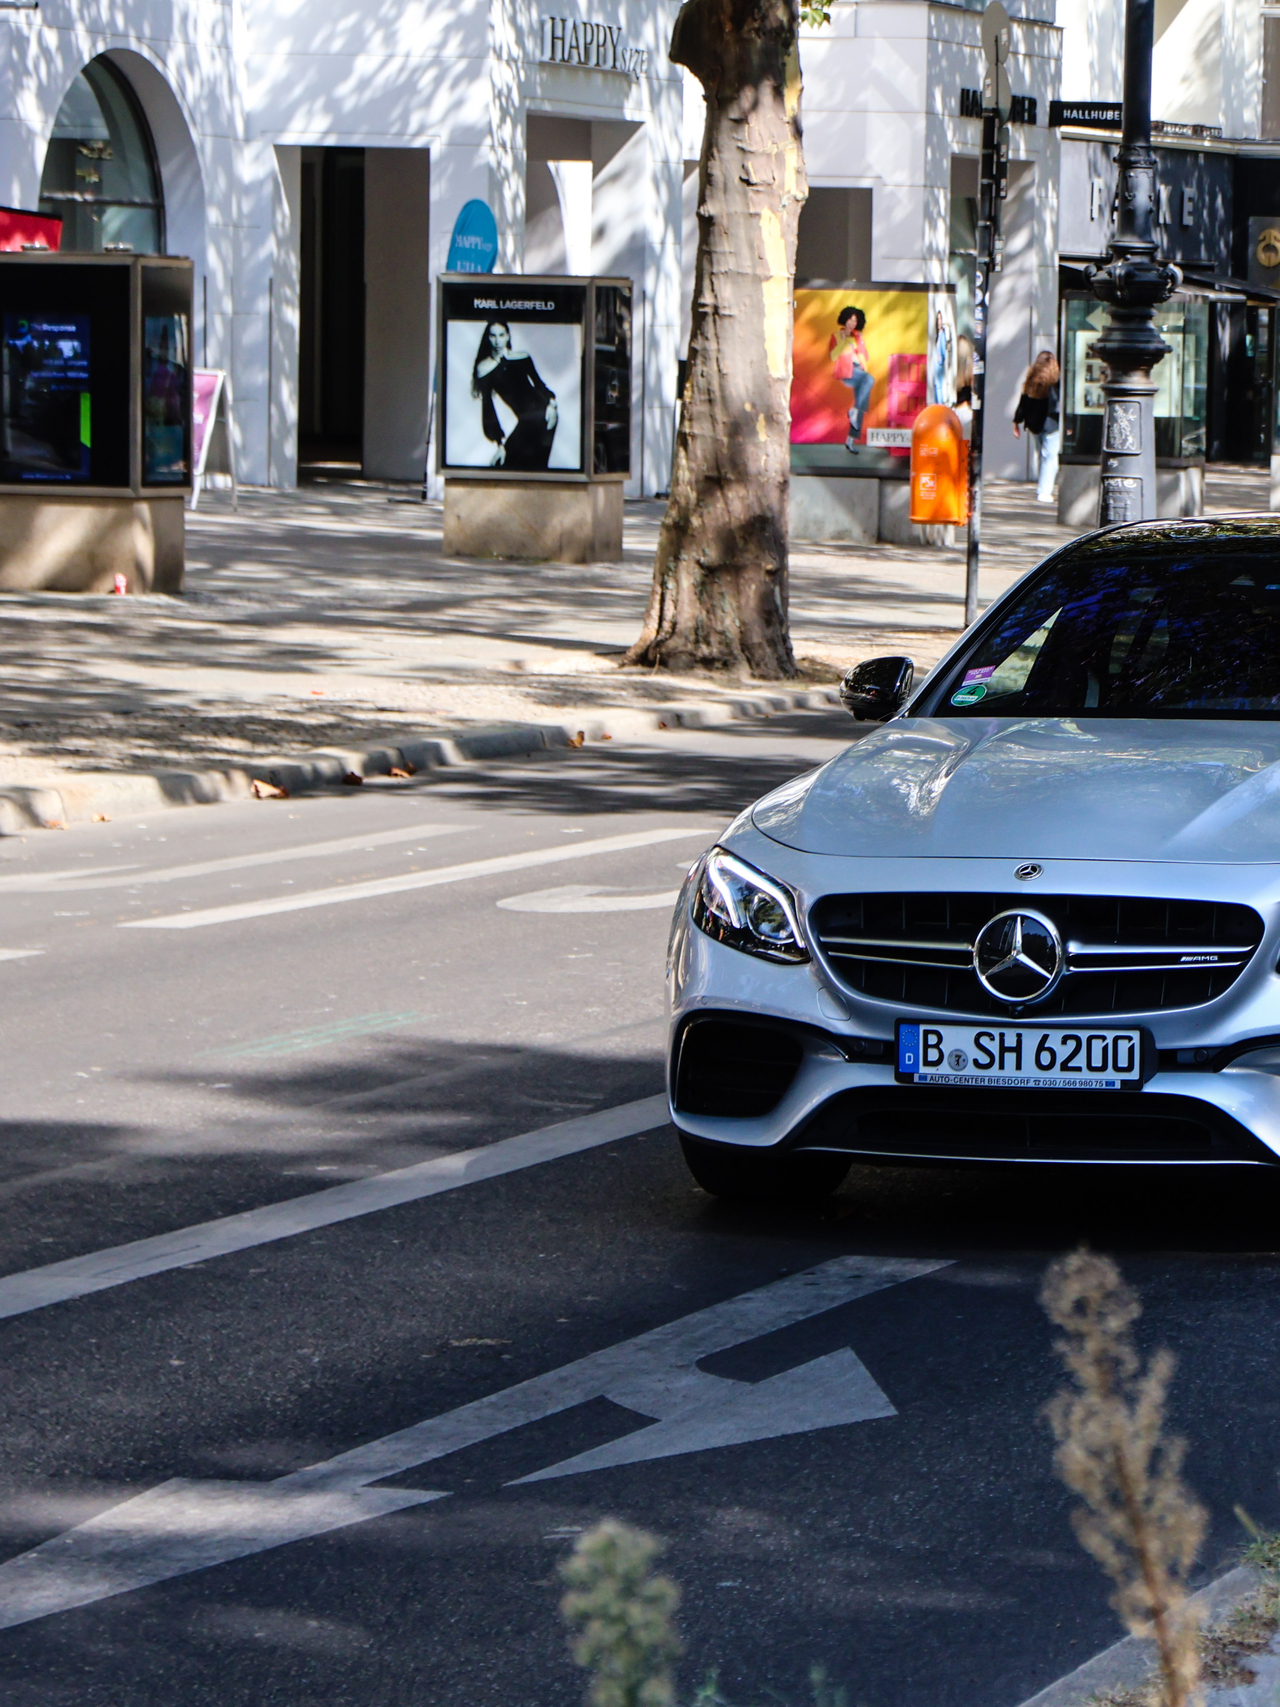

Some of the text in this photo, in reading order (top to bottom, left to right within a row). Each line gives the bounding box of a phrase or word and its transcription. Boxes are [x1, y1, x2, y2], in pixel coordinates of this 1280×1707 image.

[549, 16, 622, 70] HAPPY
[1063, 108, 1124, 121] HALLHUBE
[474, 298, 555, 310] KARL LAGERFELD
[871, 431, 907, 442] HAPPY
[966, 685, 979, 695] 4
[922, 1029, 1136, 1073] B SH 6200
[905, 1053, 914, 1064] D
[929, 1075, 986, 1085] AUTO-CENTER
[987, 1078, 1031, 1086] BIESDORF
